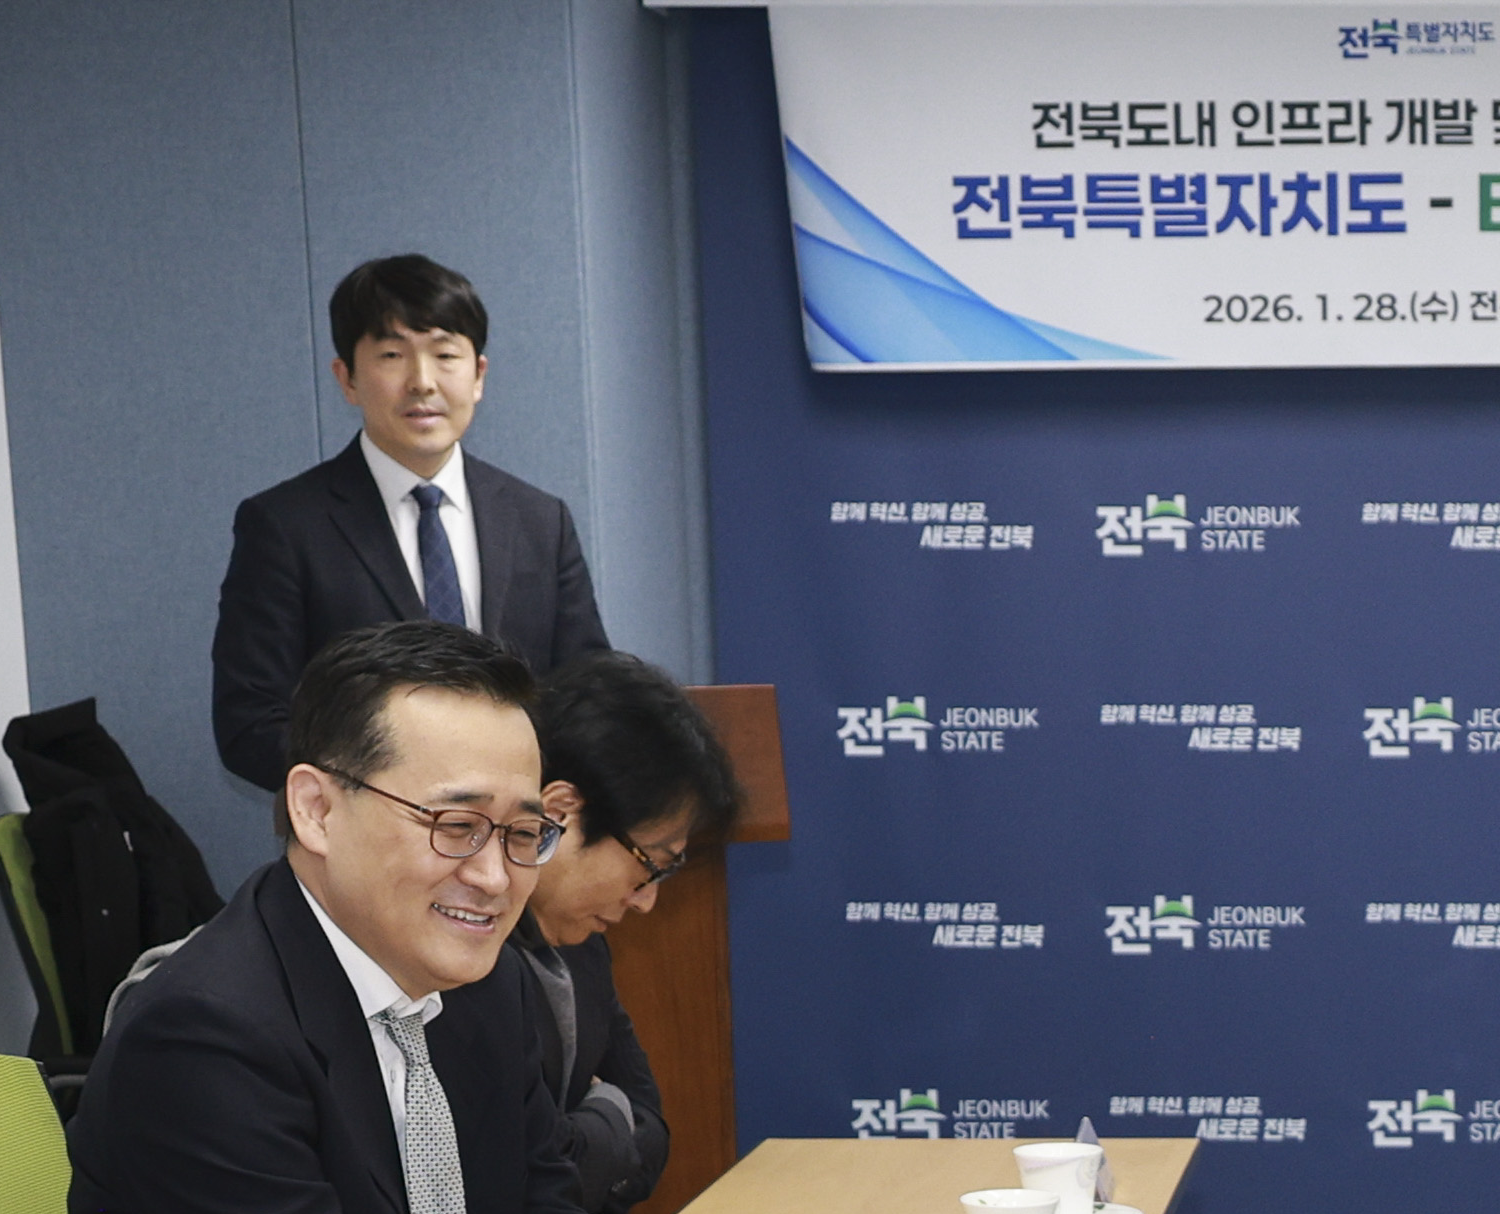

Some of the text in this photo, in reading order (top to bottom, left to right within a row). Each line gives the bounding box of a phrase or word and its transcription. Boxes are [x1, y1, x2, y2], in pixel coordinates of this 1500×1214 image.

[1339, 19, 1494, 59] 전북 특별자치도
[1032, 101, 1216, 149] 전북도내
[1232, 99, 1372, 147] 인프라
[1385, 99, 1478, 145] 개발
[952, 172, 1407, 240] 전북특별자치도
[1430, 197, 1453, 208] -
[1204, 295, 1302, 322] 2026.
[1316, 295, 1342, 321] 1.
[1354, 292, 1458, 321] 28.(수)
[831, 501, 867, 523] 함께
[912, 501, 950, 523] 함께
[1200, 506, 1300, 527] JEONBUK
[1362, 501, 1398, 523] 함께
[1443, 501, 1481, 523] 함께
[1096, 494, 1194, 557] 전북
[920, 525, 1034, 550] 새로운 전북
[1201, 530, 1265, 551] STATE
[940, 708, 1039, 728] JEONBUK
[1100, 703, 1135, 725] 함께
[1180, 703, 1218, 725] 함께
[837, 696, 935, 757] 전북
[1363, 697, 1461, 758] 전북
[941, 731, 1004, 752] STATE
[1188, 726, 1301, 751] 새로운 전북
[846, 901, 881, 922] 함께
[925, 901, 962, 922] 함께
[1208, 906, 1305, 926] JEONBUK
[1365, 902, 1400, 923] 함께
[1445, 902, 1482, 923] 함께
[1105, 895, 1202, 955] 전북
[932, 925, 1044, 948] 새로운 전북
[1208, 929, 1270, 949] STATE
[953, 1100, 1049, 1119] JEONBUK
[1110, 1095, 1145, 1116] 함께
[1188, 1095, 1225, 1116] 함께
[1367, 1089, 1463, 1148] 전북
[954, 1122, 1015, 1138] STATE
[1197, 1118, 1307, 1142] 새로운 전북
